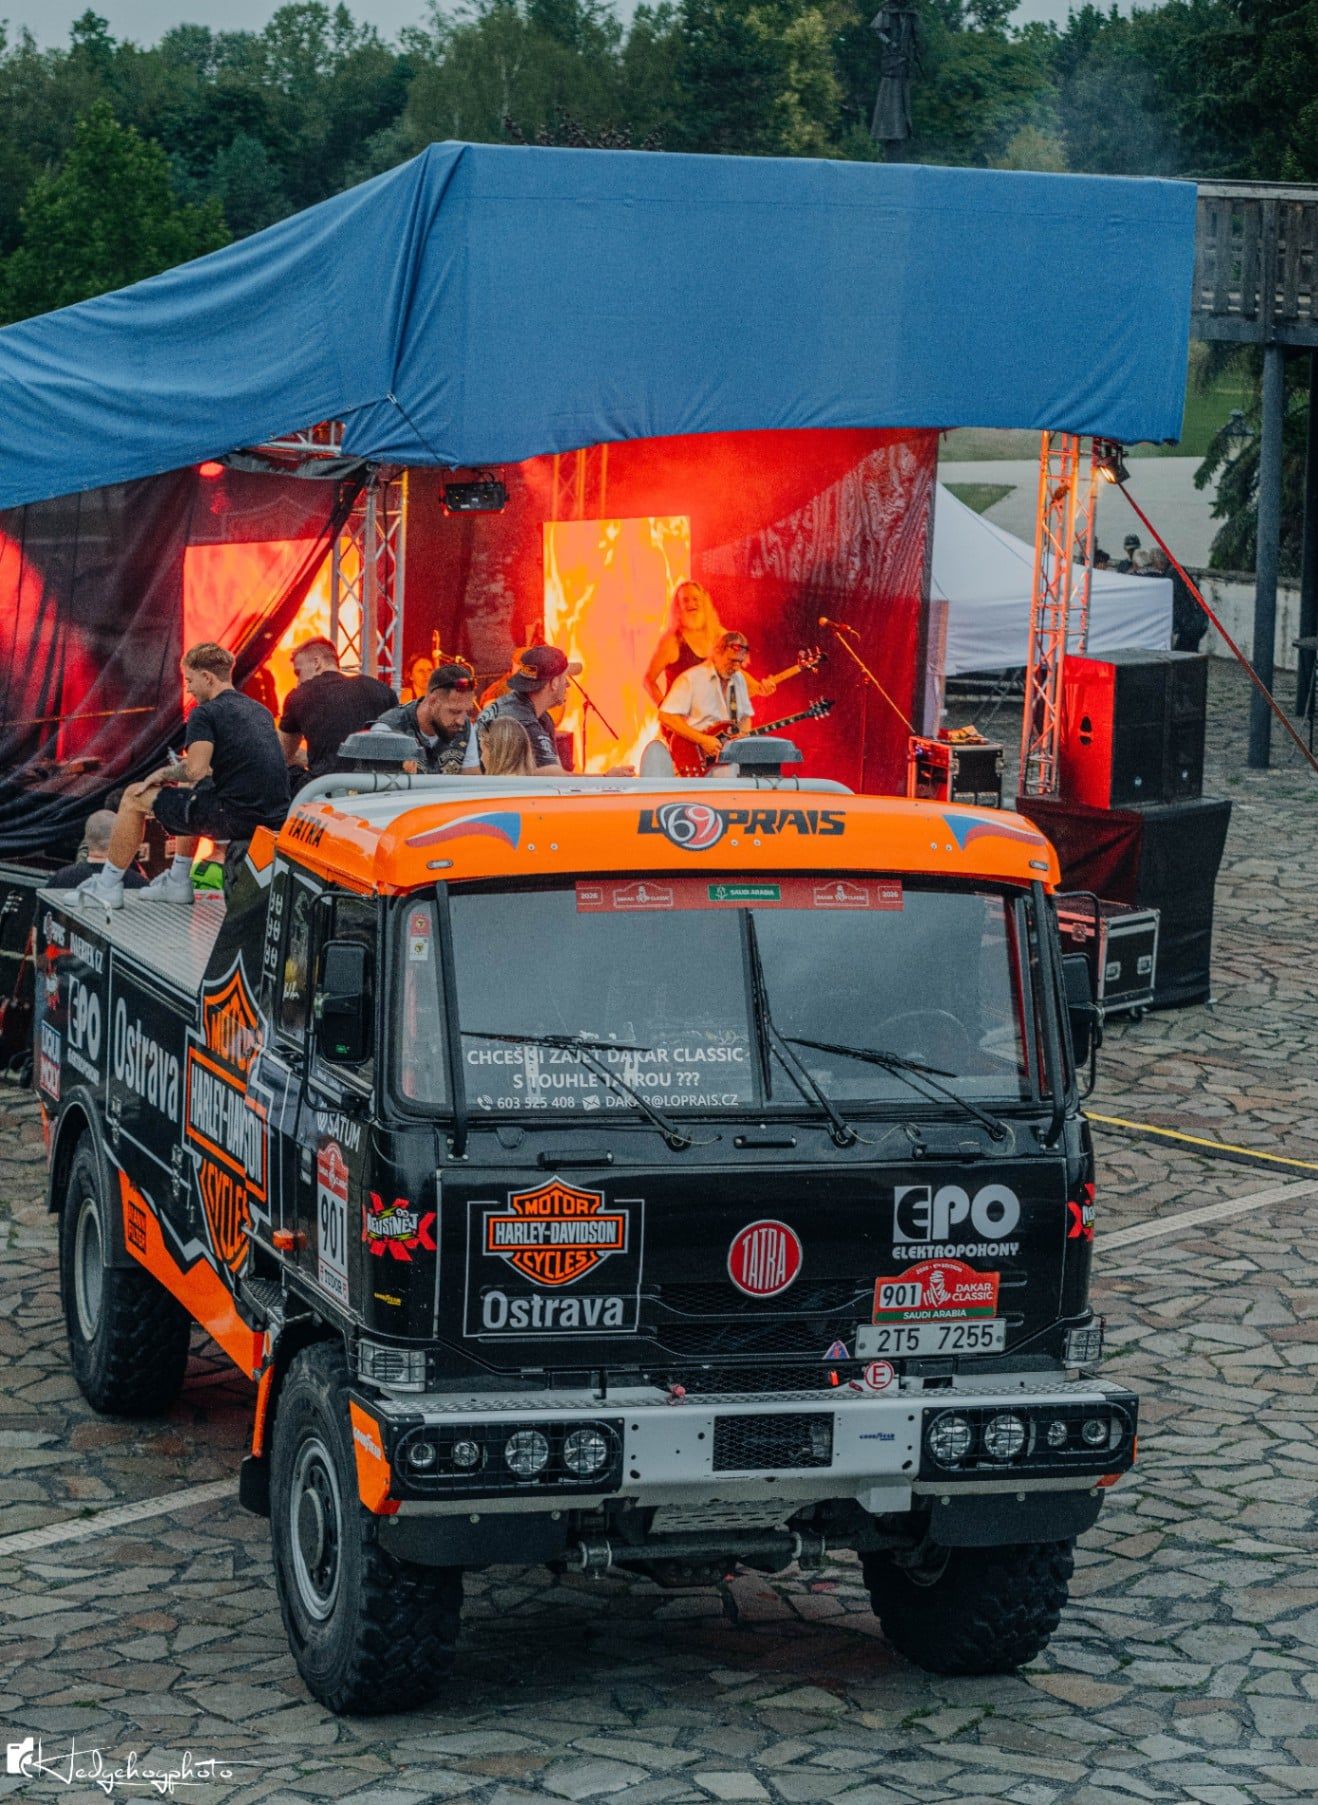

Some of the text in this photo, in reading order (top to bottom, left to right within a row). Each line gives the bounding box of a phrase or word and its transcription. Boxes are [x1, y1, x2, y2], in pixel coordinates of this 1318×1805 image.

[288, 811, 328, 848] TATRA
[67, 974, 101, 1061] EPO
[114, 997, 179, 1123] Ostrava
[467, 1046, 523, 1065] CHCEŠ
[607, 1048, 669, 1063] DAKAR
[673, 1047, 744, 1062] CLASSIC
[513, 1074, 523, 1089] S
[529, 1073, 598, 1088] TOUHLE
[676, 1072, 700, 1087] ???
[497, 1096, 575, 1109] 603 525 408
[605, 1094, 739, 1108] DAKR@LOPRAIS.CZ
[328, 1112, 361, 1153] SATUM
[524, 1188, 589, 1215] MOTOR
[892, 1184, 1021, 1243] EPO
[320, 1193, 345, 1266] 901
[494, 1221, 617, 1245] HARLEY-DAVIDSON
[741, 1228, 787, 1290] TATRA
[891, 1242, 1020, 1260] ELEKTROPOHONY
[522, 1251, 588, 1279] CYCLES
[882, 1284, 917, 1307] 901
[952, 1291, 993, 1302] CLASSIC
[955, 1283, 992, 1293] DAKAR
[482, 1290, 624, 1329] Ostrava
[903, 1308, 967, 1321] SAUDI ARABIA
[877, 1324, 994, 1353] 2T5 7255
[872, 1364, 886, 1385] E
